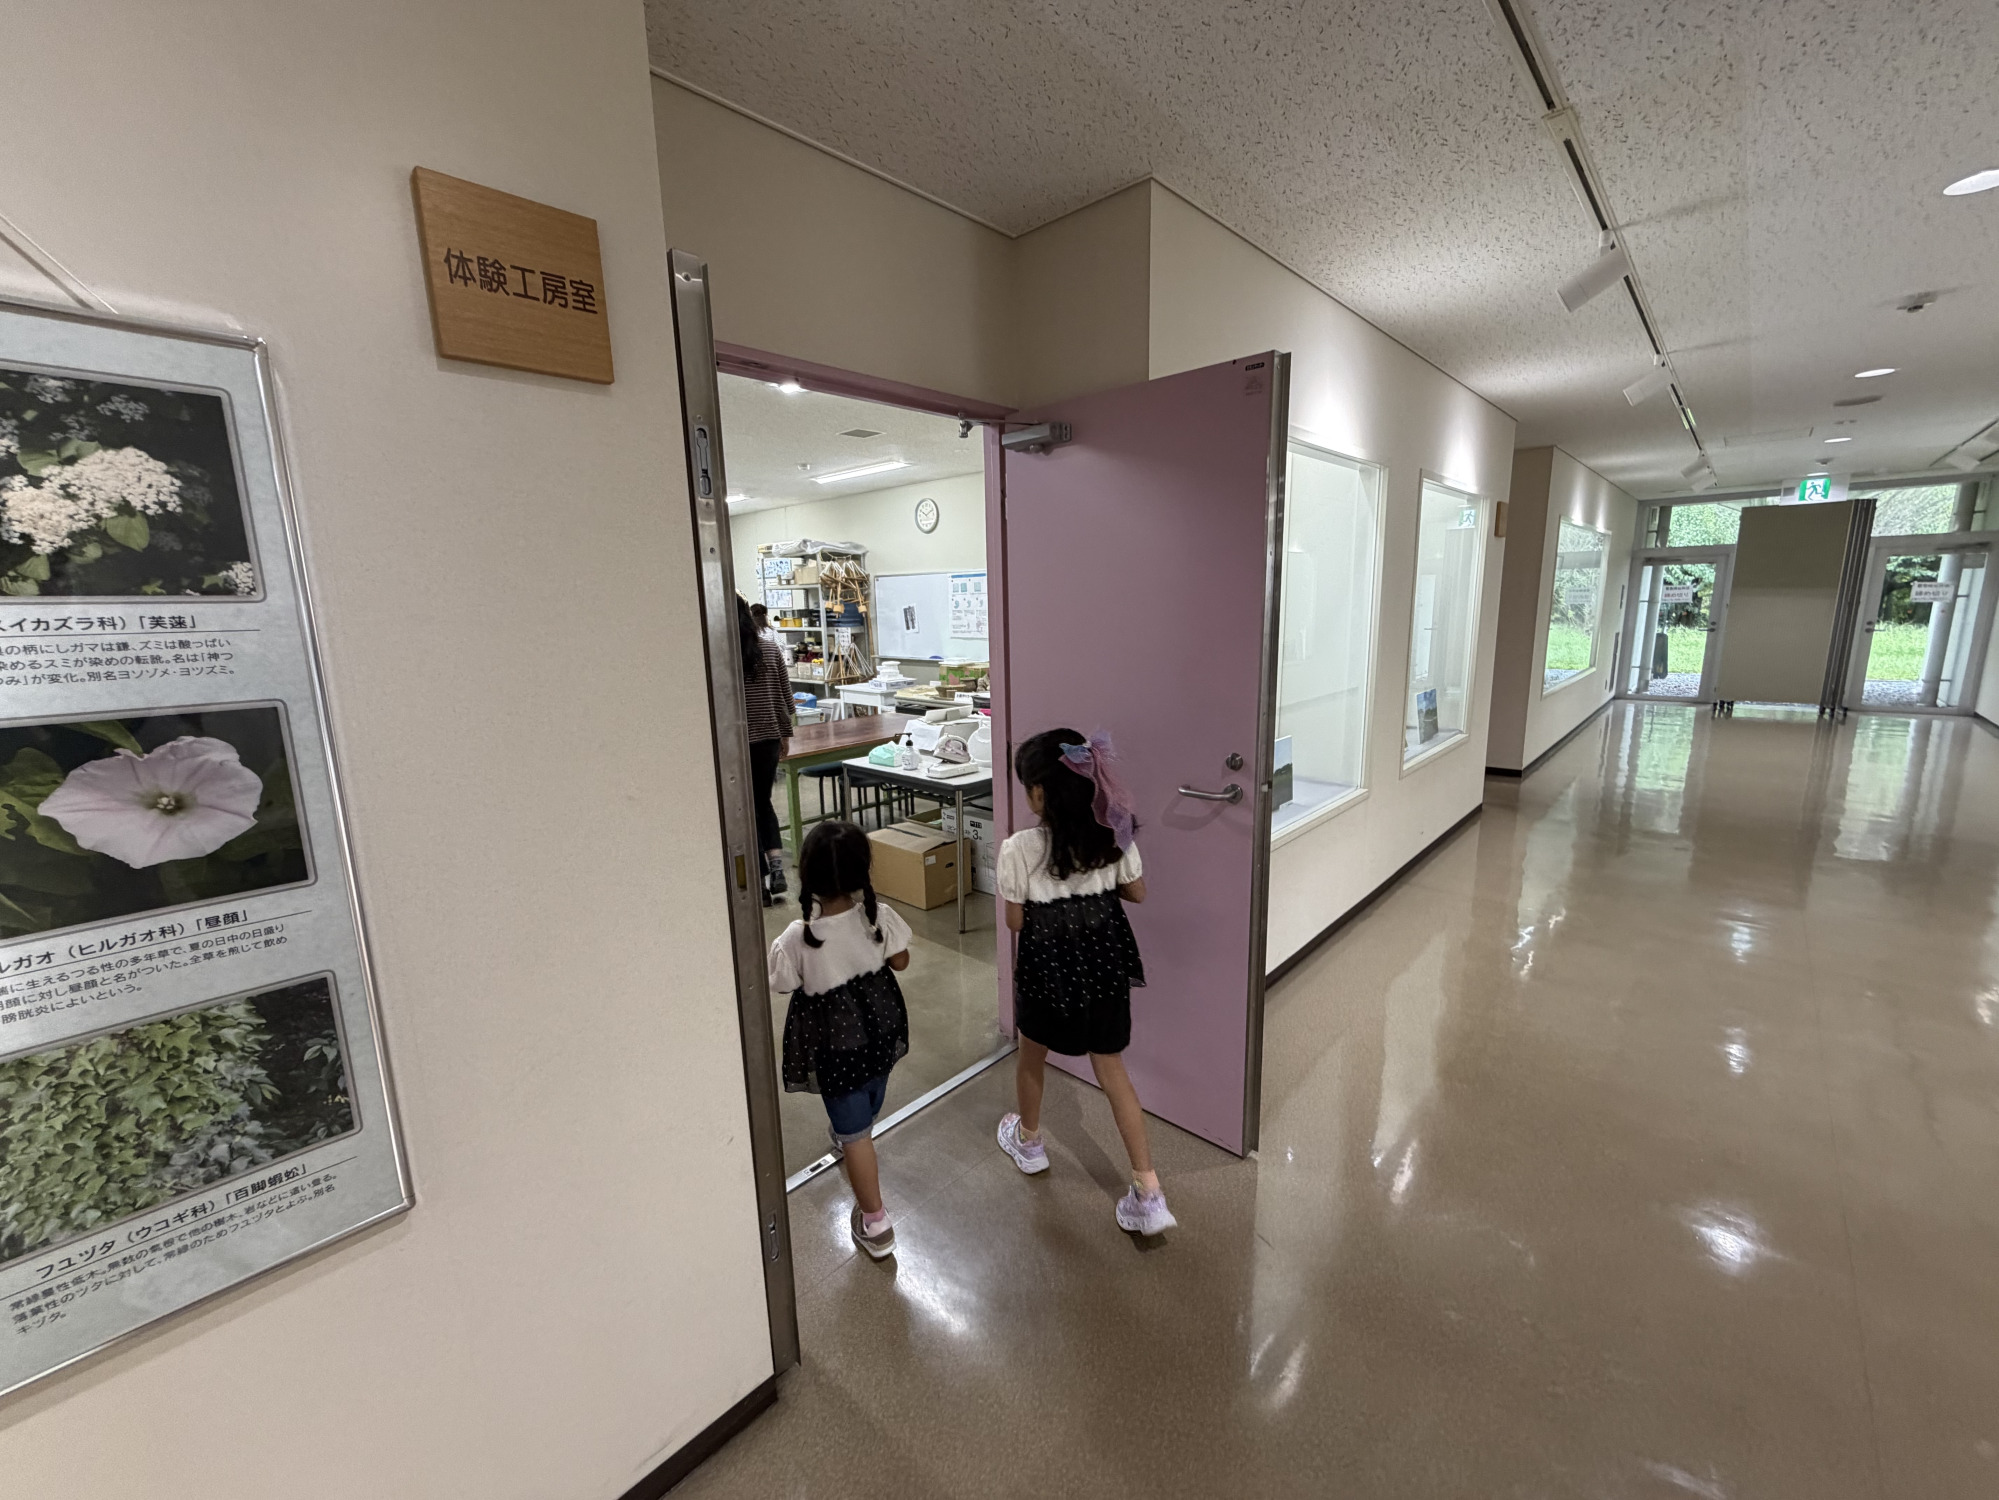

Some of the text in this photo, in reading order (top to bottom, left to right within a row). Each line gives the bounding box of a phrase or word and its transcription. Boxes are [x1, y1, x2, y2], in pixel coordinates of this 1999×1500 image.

[443, 247, 598, 314] 体験工房室
[0, 665, 235, 686] み」が変化。別名ヨソゾメ・ヨツズミ。
[0, 936, 287, 1011] 顔に対し昼顔と名がついた。全草を煎じて飲め
